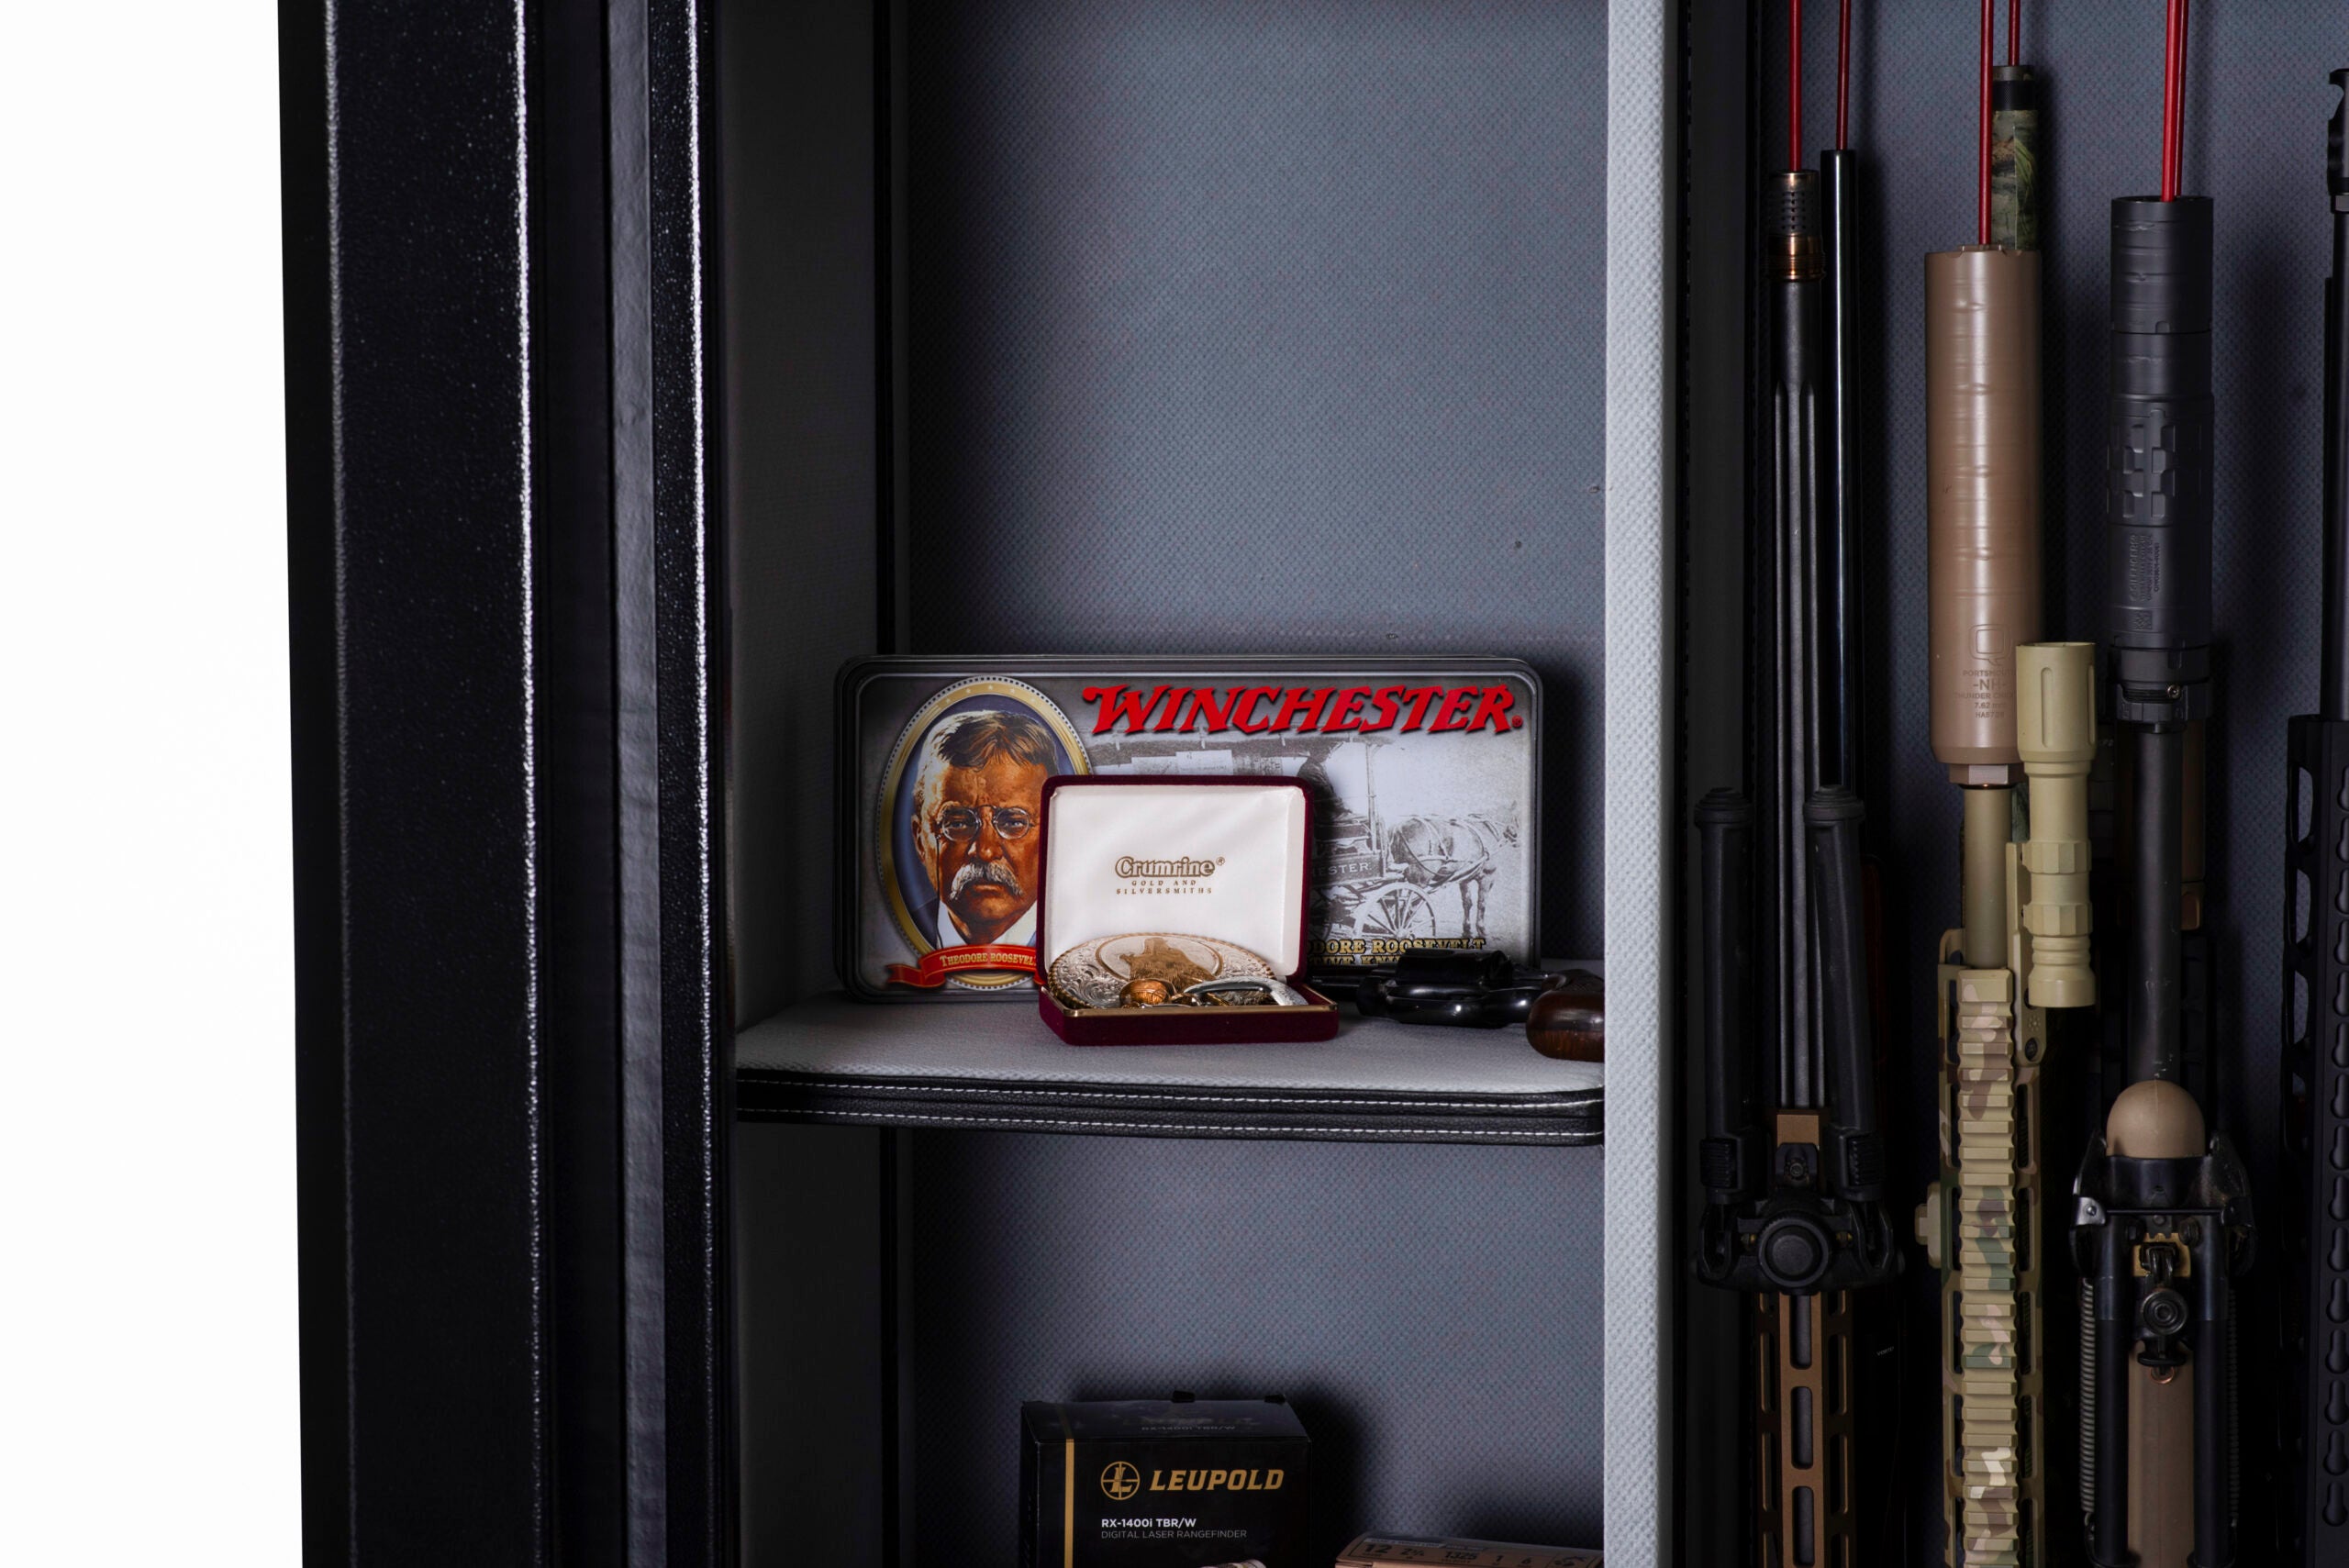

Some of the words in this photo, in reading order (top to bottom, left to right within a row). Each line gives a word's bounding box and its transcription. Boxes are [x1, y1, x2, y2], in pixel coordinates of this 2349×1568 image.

[1115, 856, 1215, 878] Crumrine
[940, 953, 989, 967] THEODORE
[990, 952, 1037, 966] ROOSEVEL
[1149, 1469, 1285, 1491] LEUPOLD
[1101, 1518, 1152, 1528] RX-1400i
[1156, 1518, 1197, 1529] TBR/W
[1101, 1530, 1140, 1539] DIGITAL
[1142, 1530, 1174, 1539] LASER
[1176, 1529, 1247, 1539] RANGEFINDER
[1364, 1543, 1393, 1553] 12
